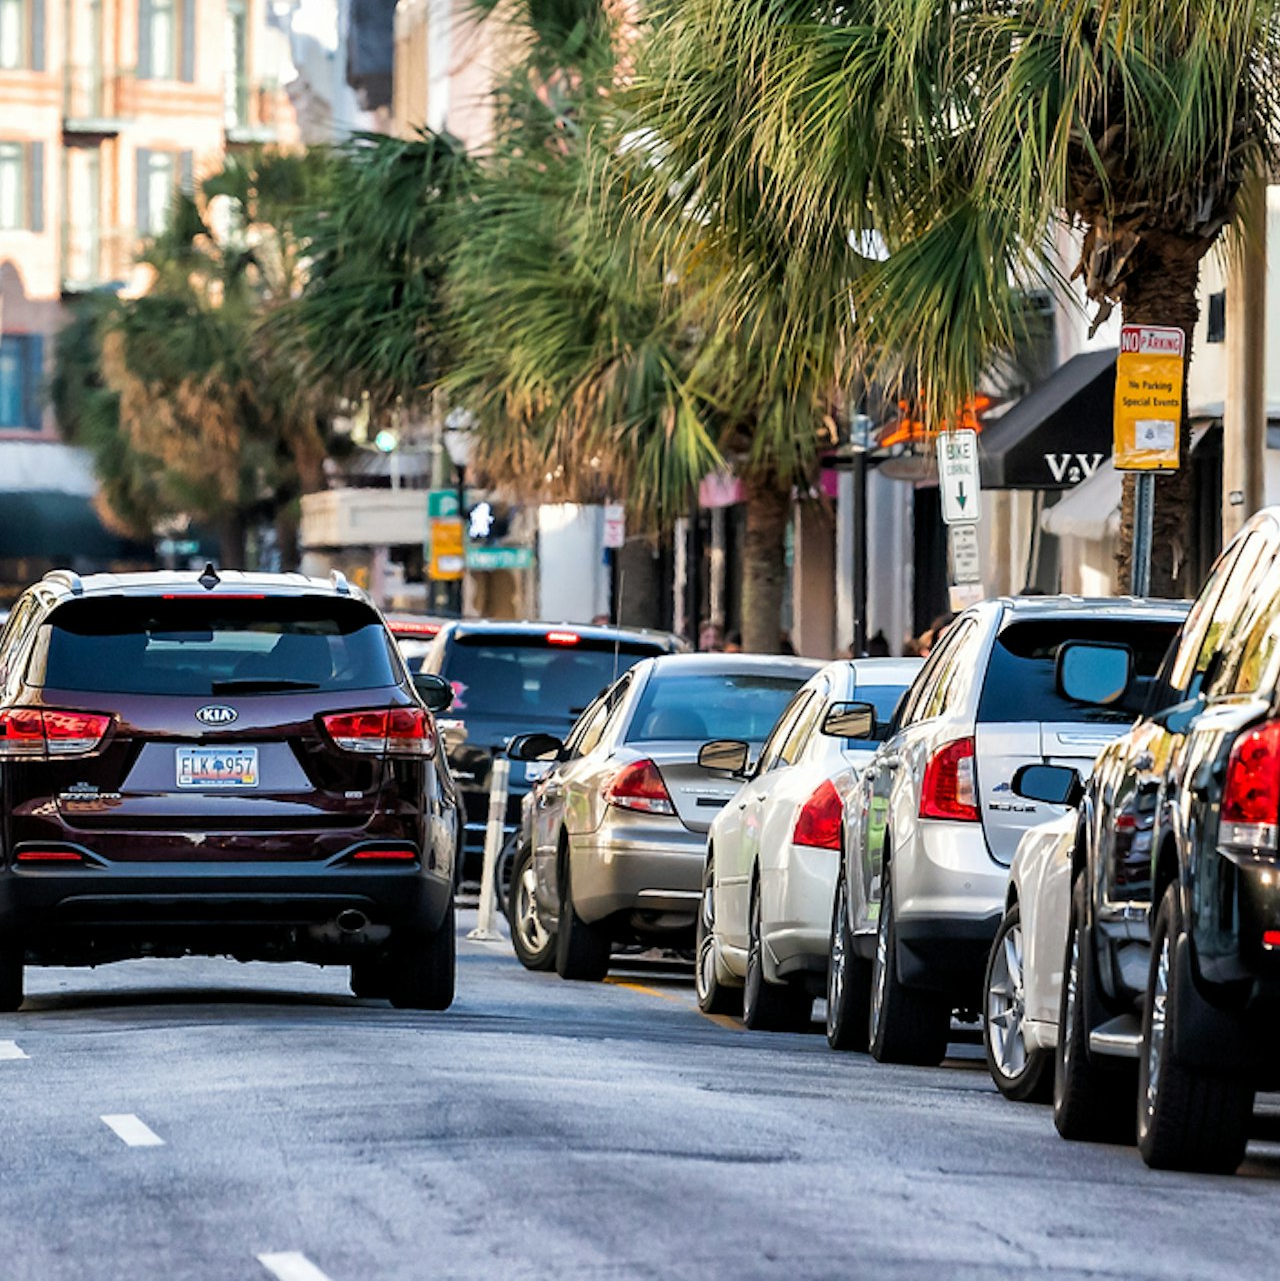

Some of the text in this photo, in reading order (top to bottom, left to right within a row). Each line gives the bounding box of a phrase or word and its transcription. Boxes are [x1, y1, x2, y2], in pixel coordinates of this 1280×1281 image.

[1121, 332, 1179, 352] NO PARKING
[1142, 380, 1172, 393] Parking
[1122, 396, 1179, 408] Special Events
[203, 709, 231, 722] KIA
[182, 757, 253, 776] FLK 957
